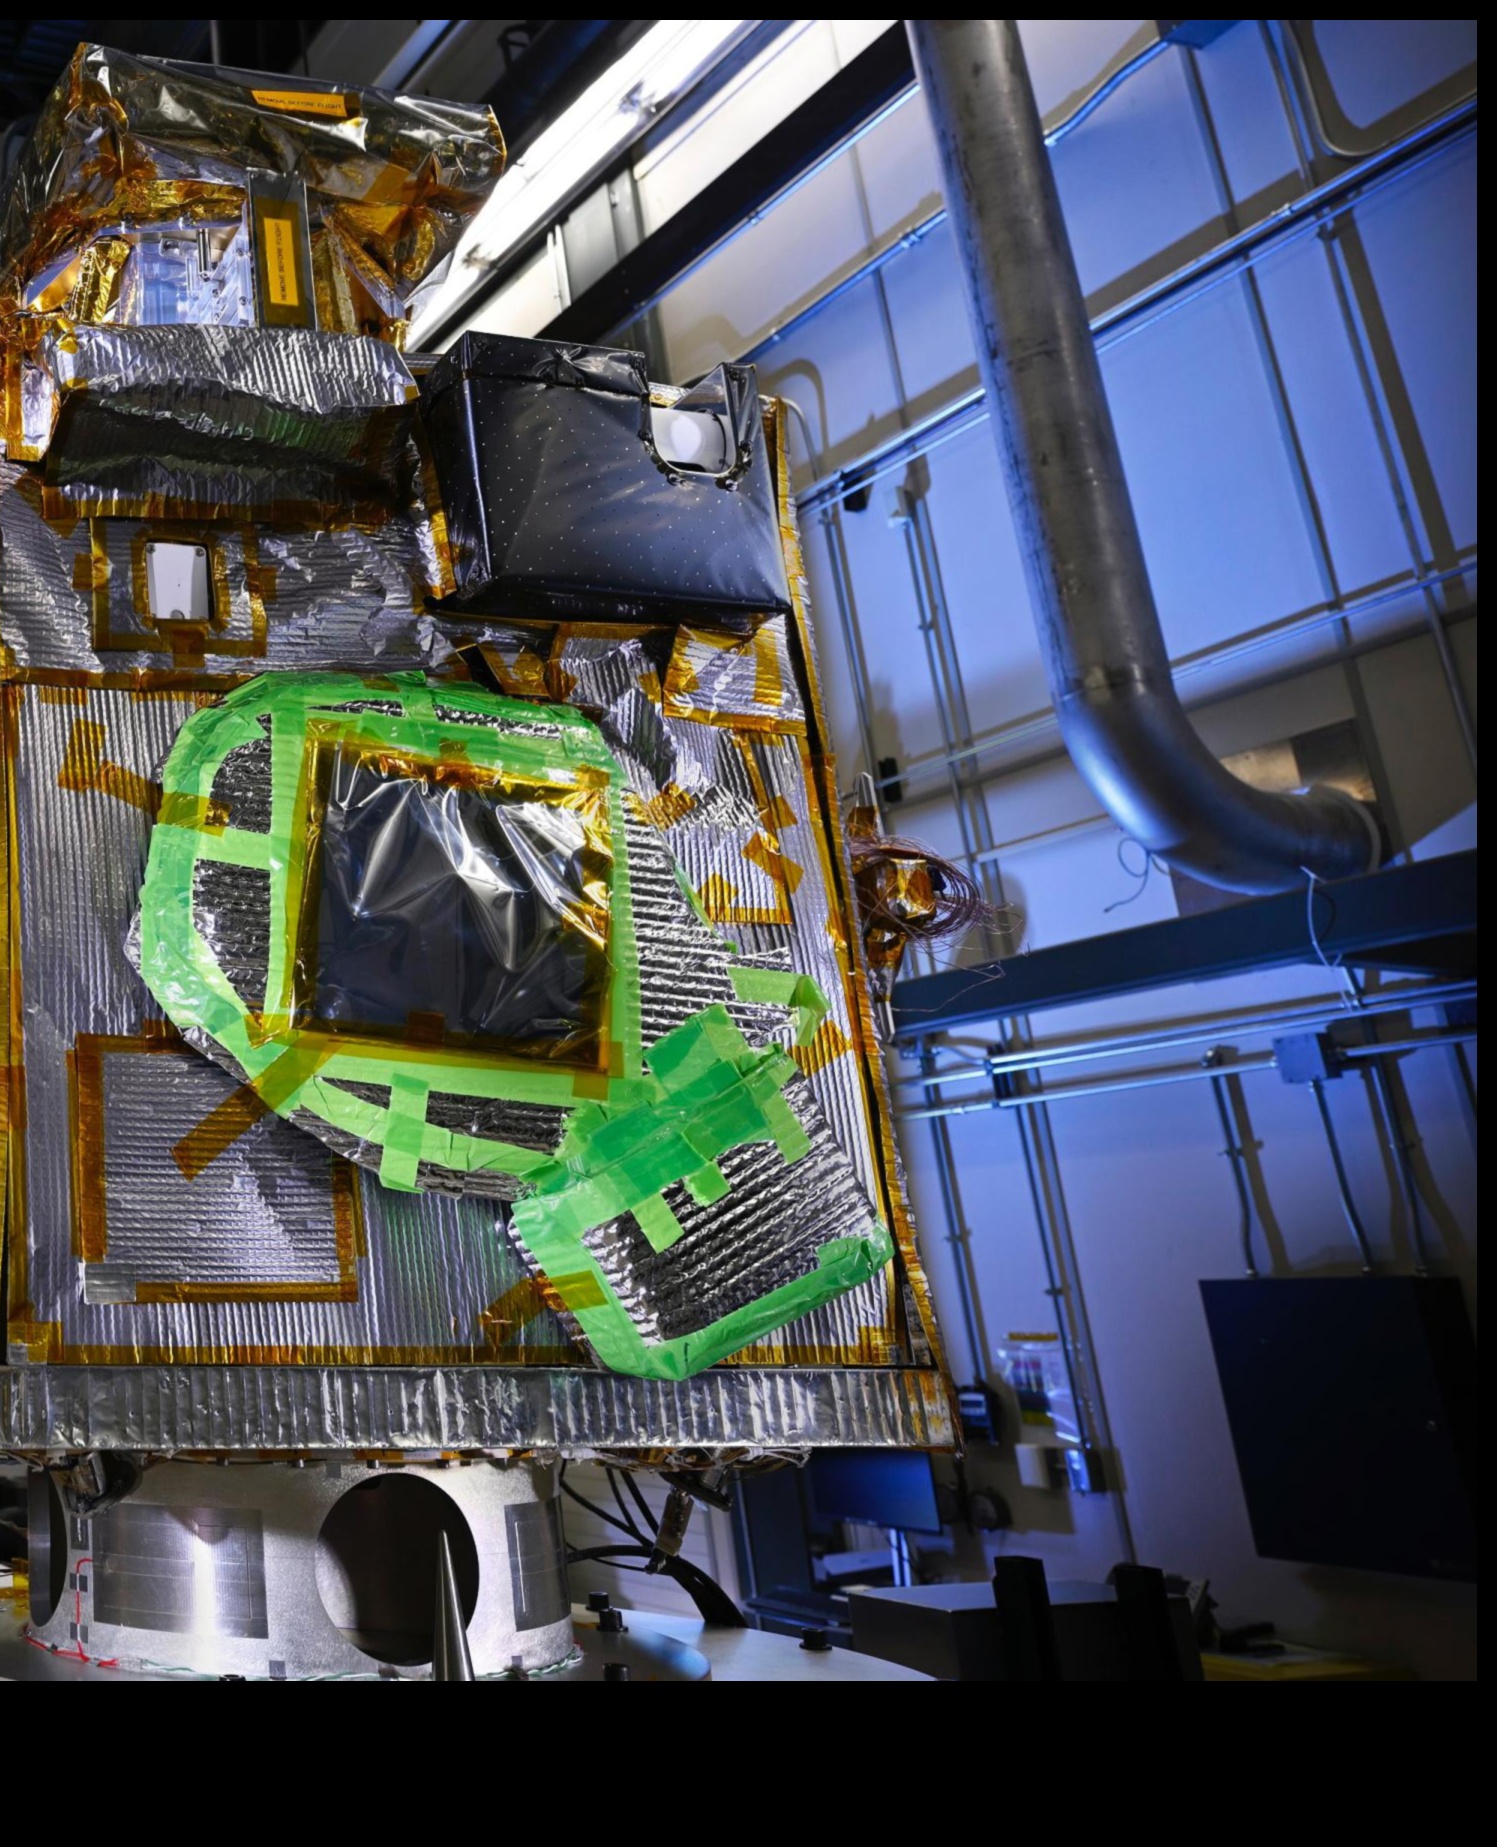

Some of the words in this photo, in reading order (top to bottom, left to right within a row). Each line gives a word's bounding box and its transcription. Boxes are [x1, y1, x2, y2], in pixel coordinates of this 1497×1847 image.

[317, 102, 342, 110] FLIGHT
[277, 247, 285, 273] BEFORE
[278, 274, 287, 301] REMOVE
